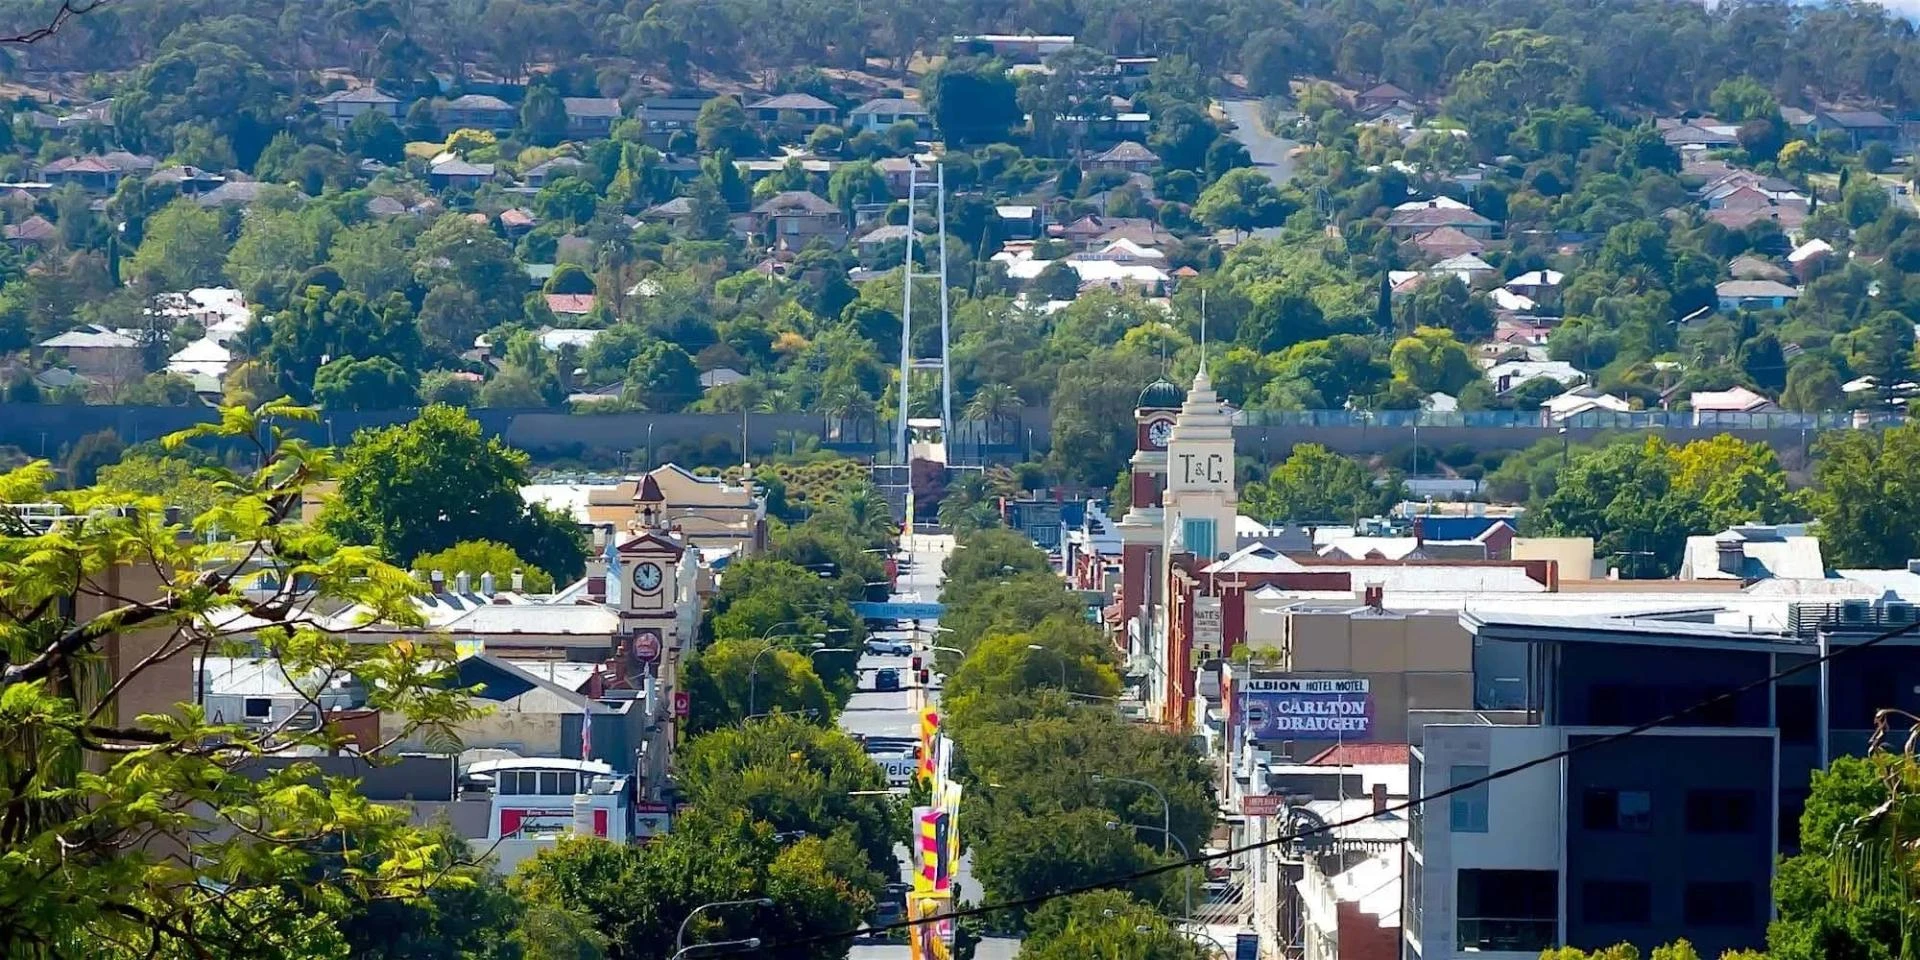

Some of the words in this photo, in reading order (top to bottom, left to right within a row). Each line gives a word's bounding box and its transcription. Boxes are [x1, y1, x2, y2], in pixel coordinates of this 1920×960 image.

[1245, 681, 1300, 691] ALBION
[1306, 681, 1332, 692] HOTEL
[1335, 681, 1365, 691] MOTEL
[1278, 700, 1366, 715] CARLTON
[1276, 716, 1369, 731] DRAUGHT
